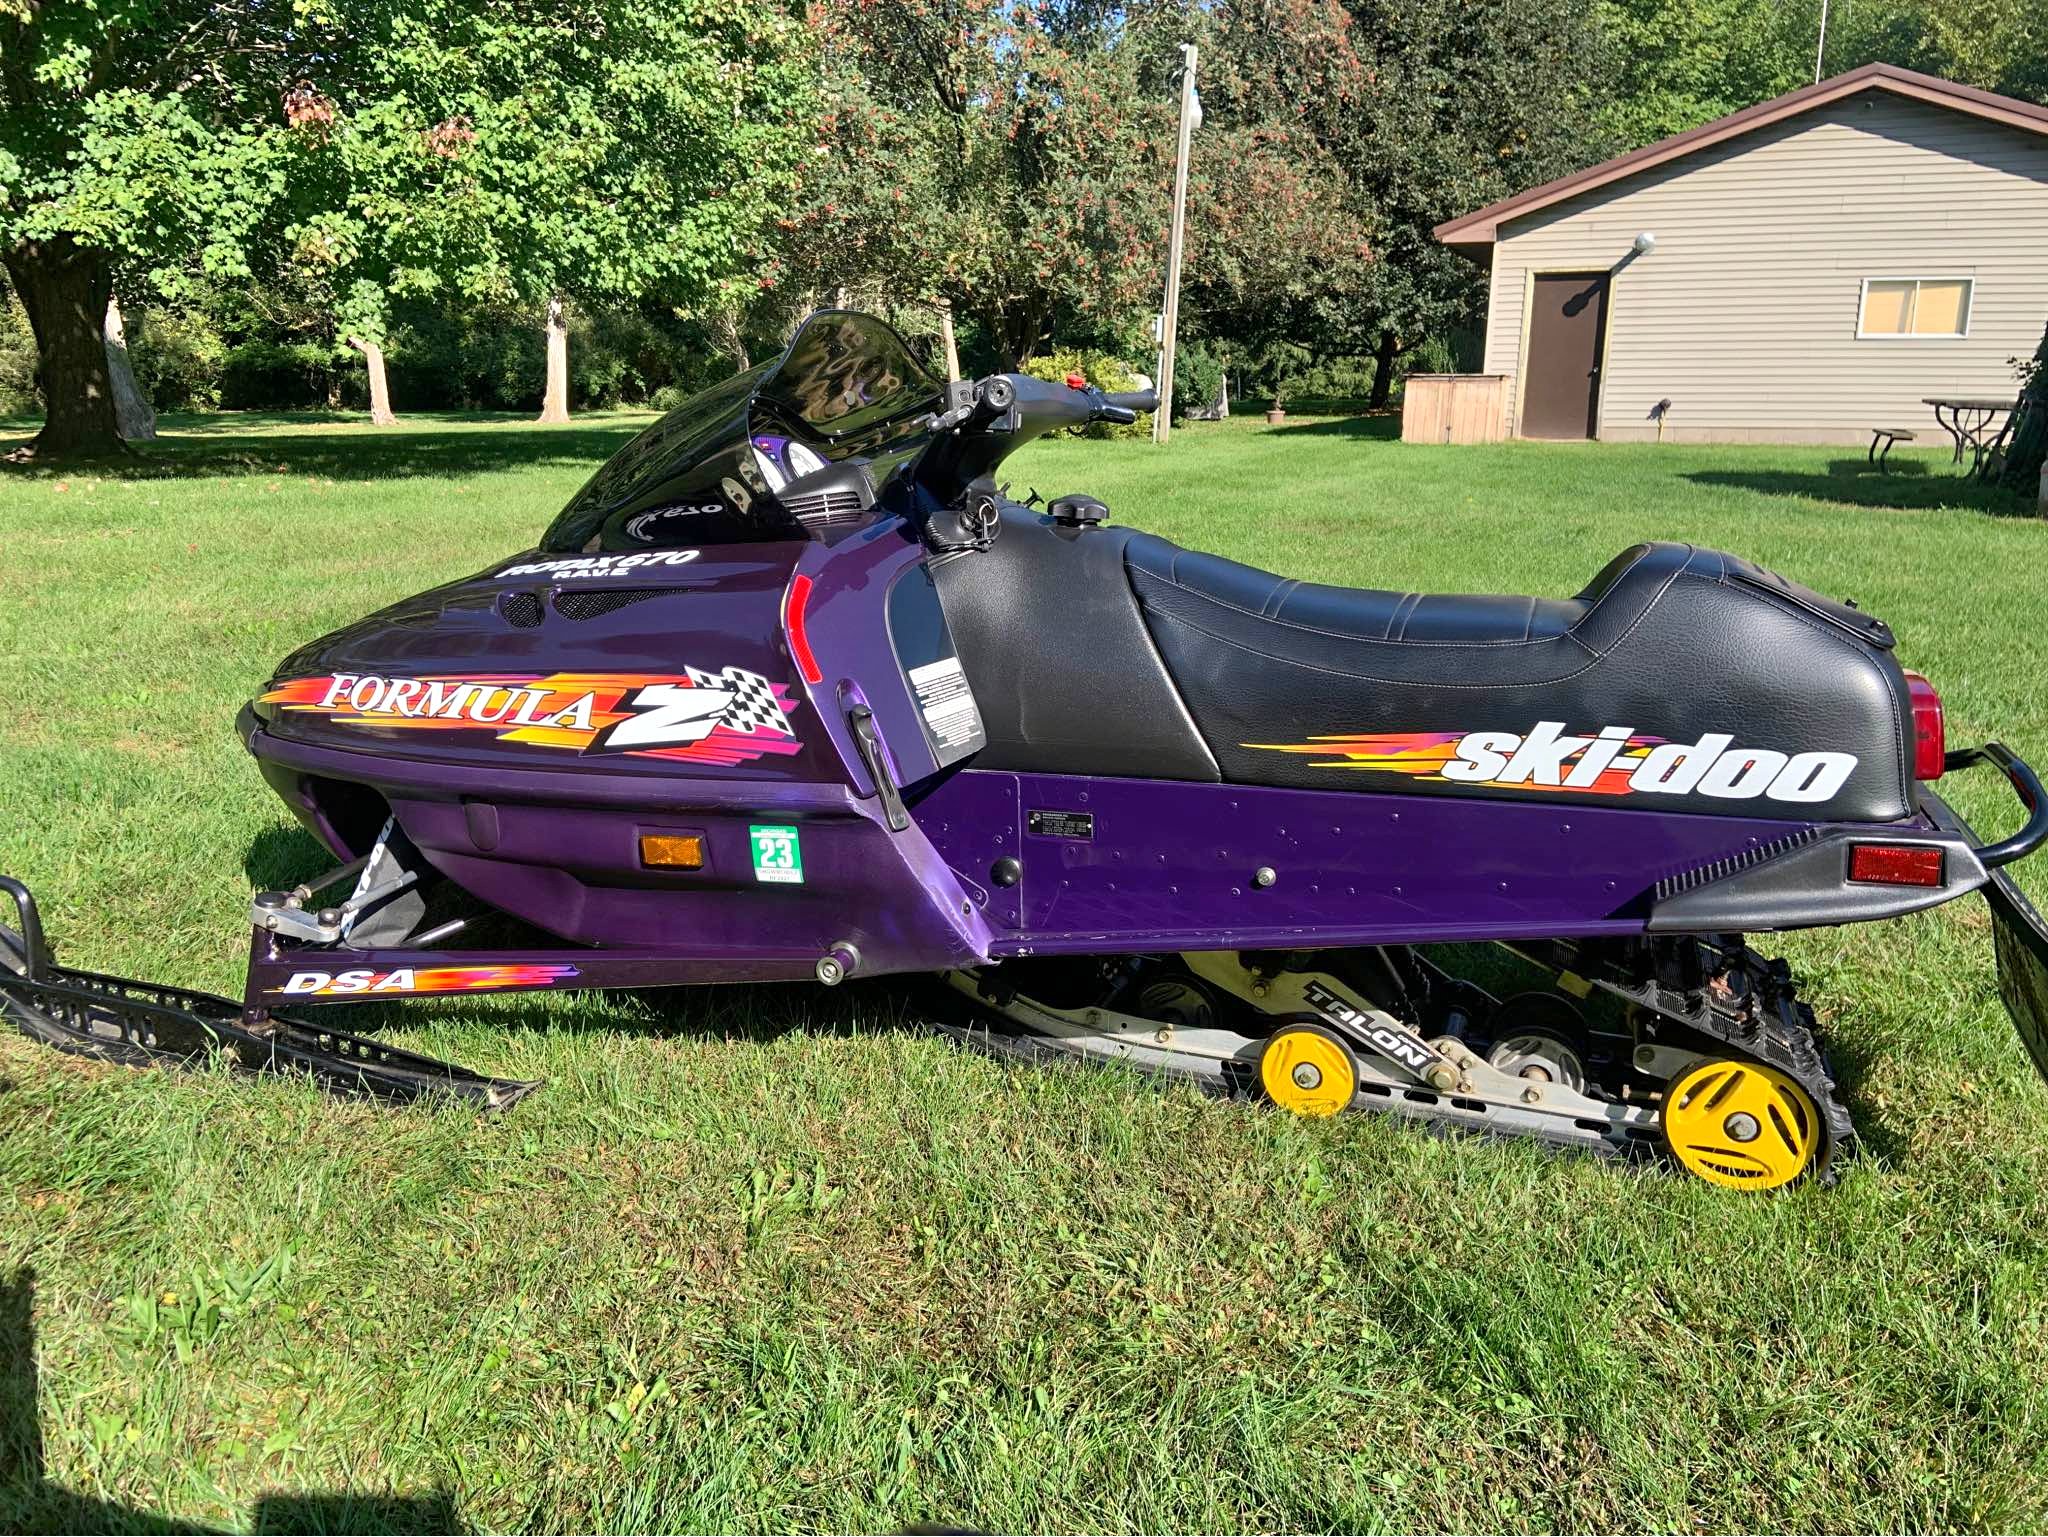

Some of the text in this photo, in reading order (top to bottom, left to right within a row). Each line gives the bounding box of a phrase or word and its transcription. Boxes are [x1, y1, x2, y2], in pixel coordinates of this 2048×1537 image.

[495, 550, 701, 578] ROTAX 670
[319, 673, 738, 747] FORMULA Z
[1441, 721, 1858, 802] ski-doo
[759, 839, 793, 867] 23
[282, 967, 416, 994] DSA
[1311, 985, 1428, 1067] TALON
